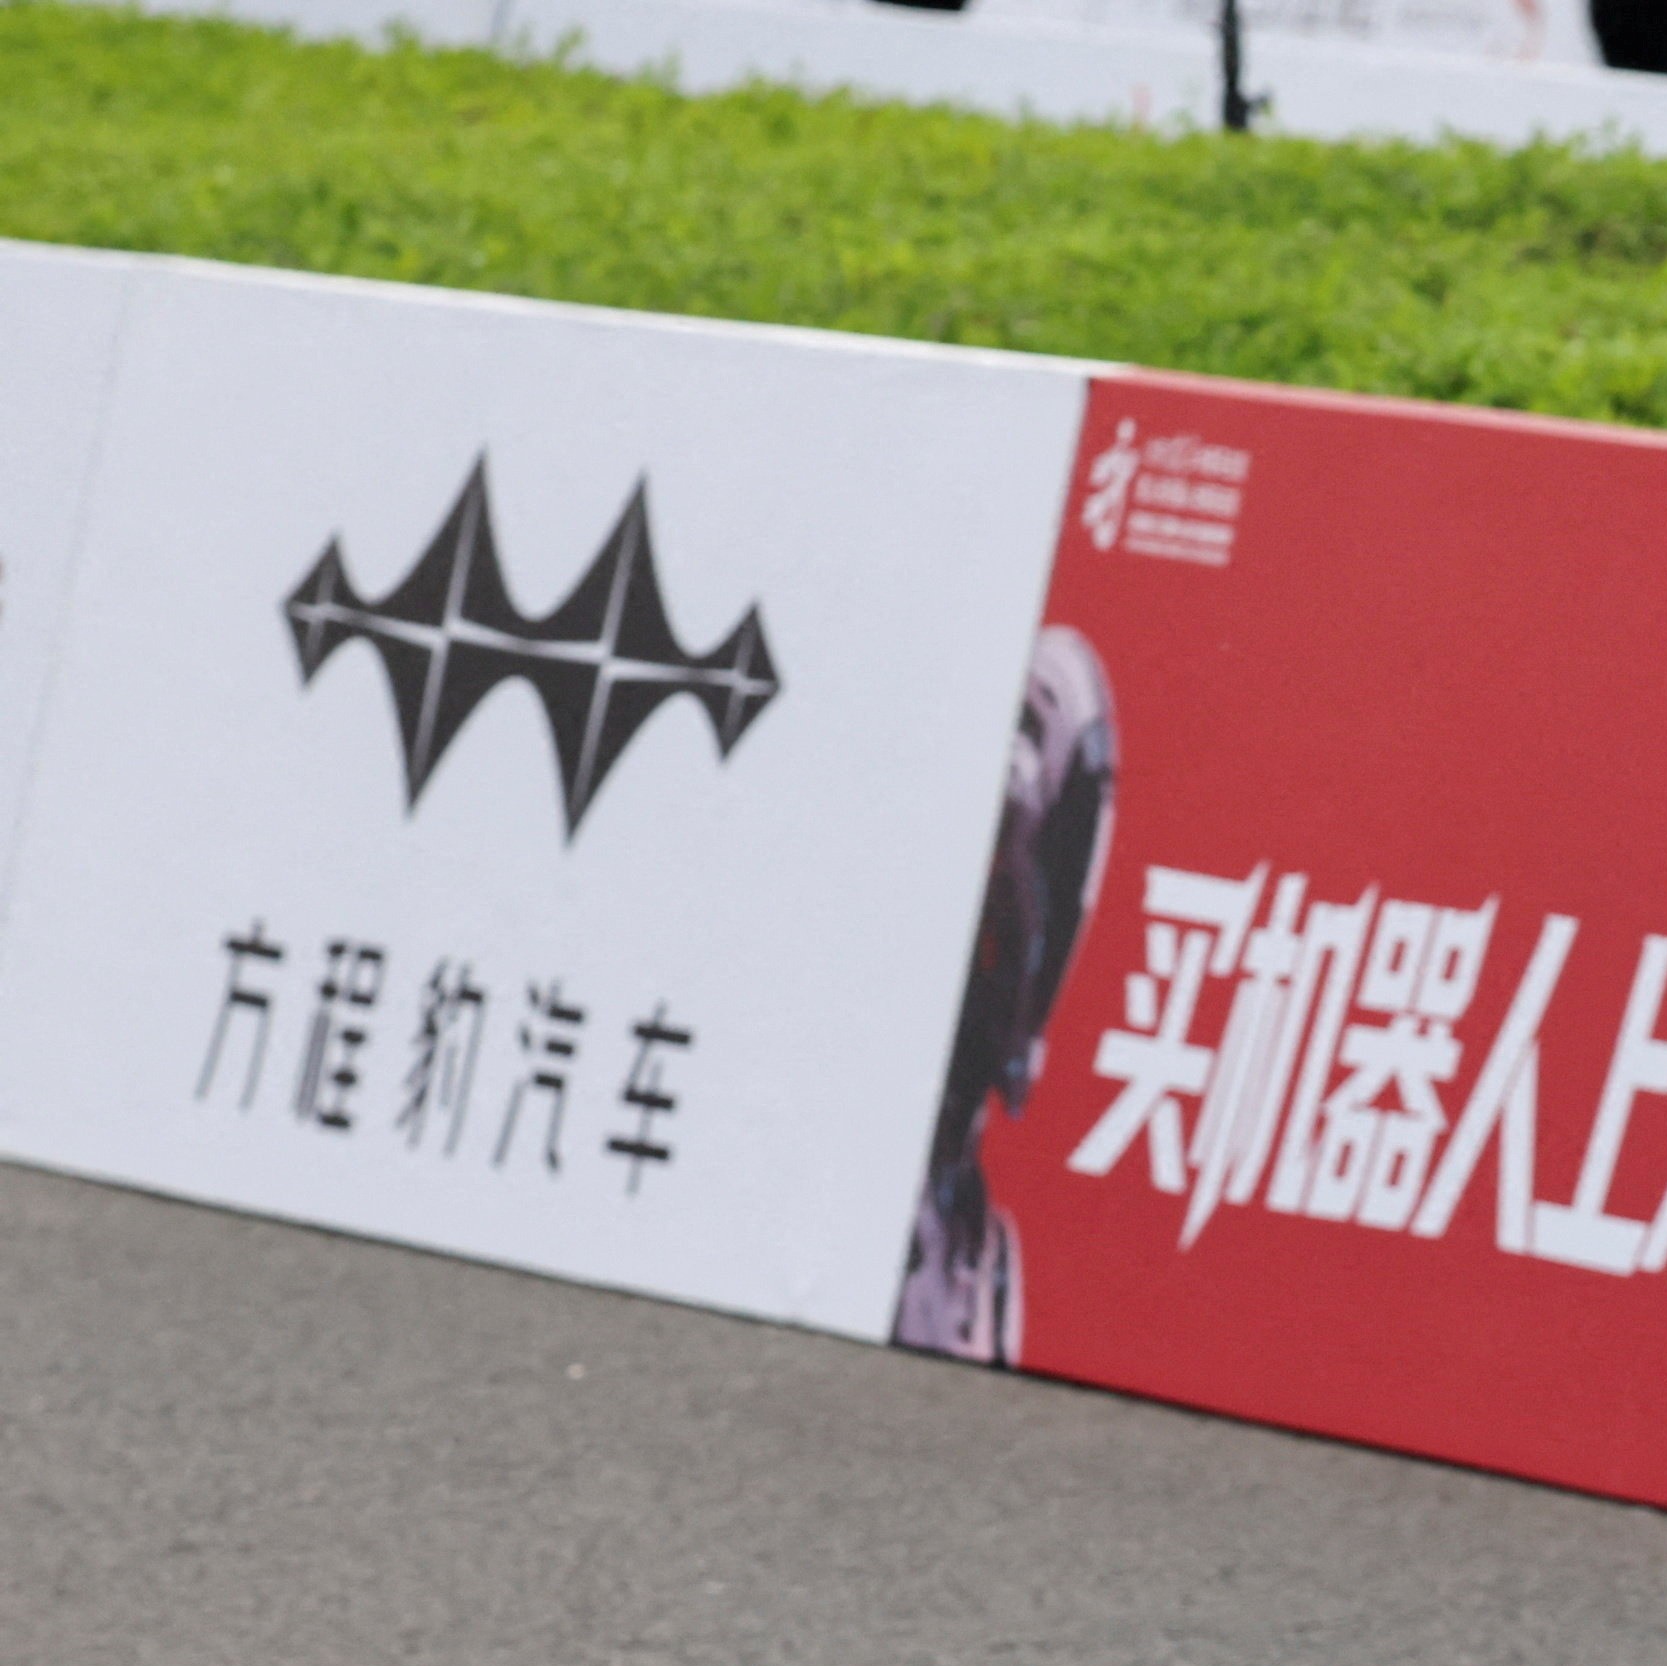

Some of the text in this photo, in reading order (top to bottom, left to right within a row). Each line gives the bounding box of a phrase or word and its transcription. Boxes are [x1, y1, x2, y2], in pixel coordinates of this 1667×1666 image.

[195, 920, 692, 1195] 方程豹汽车
